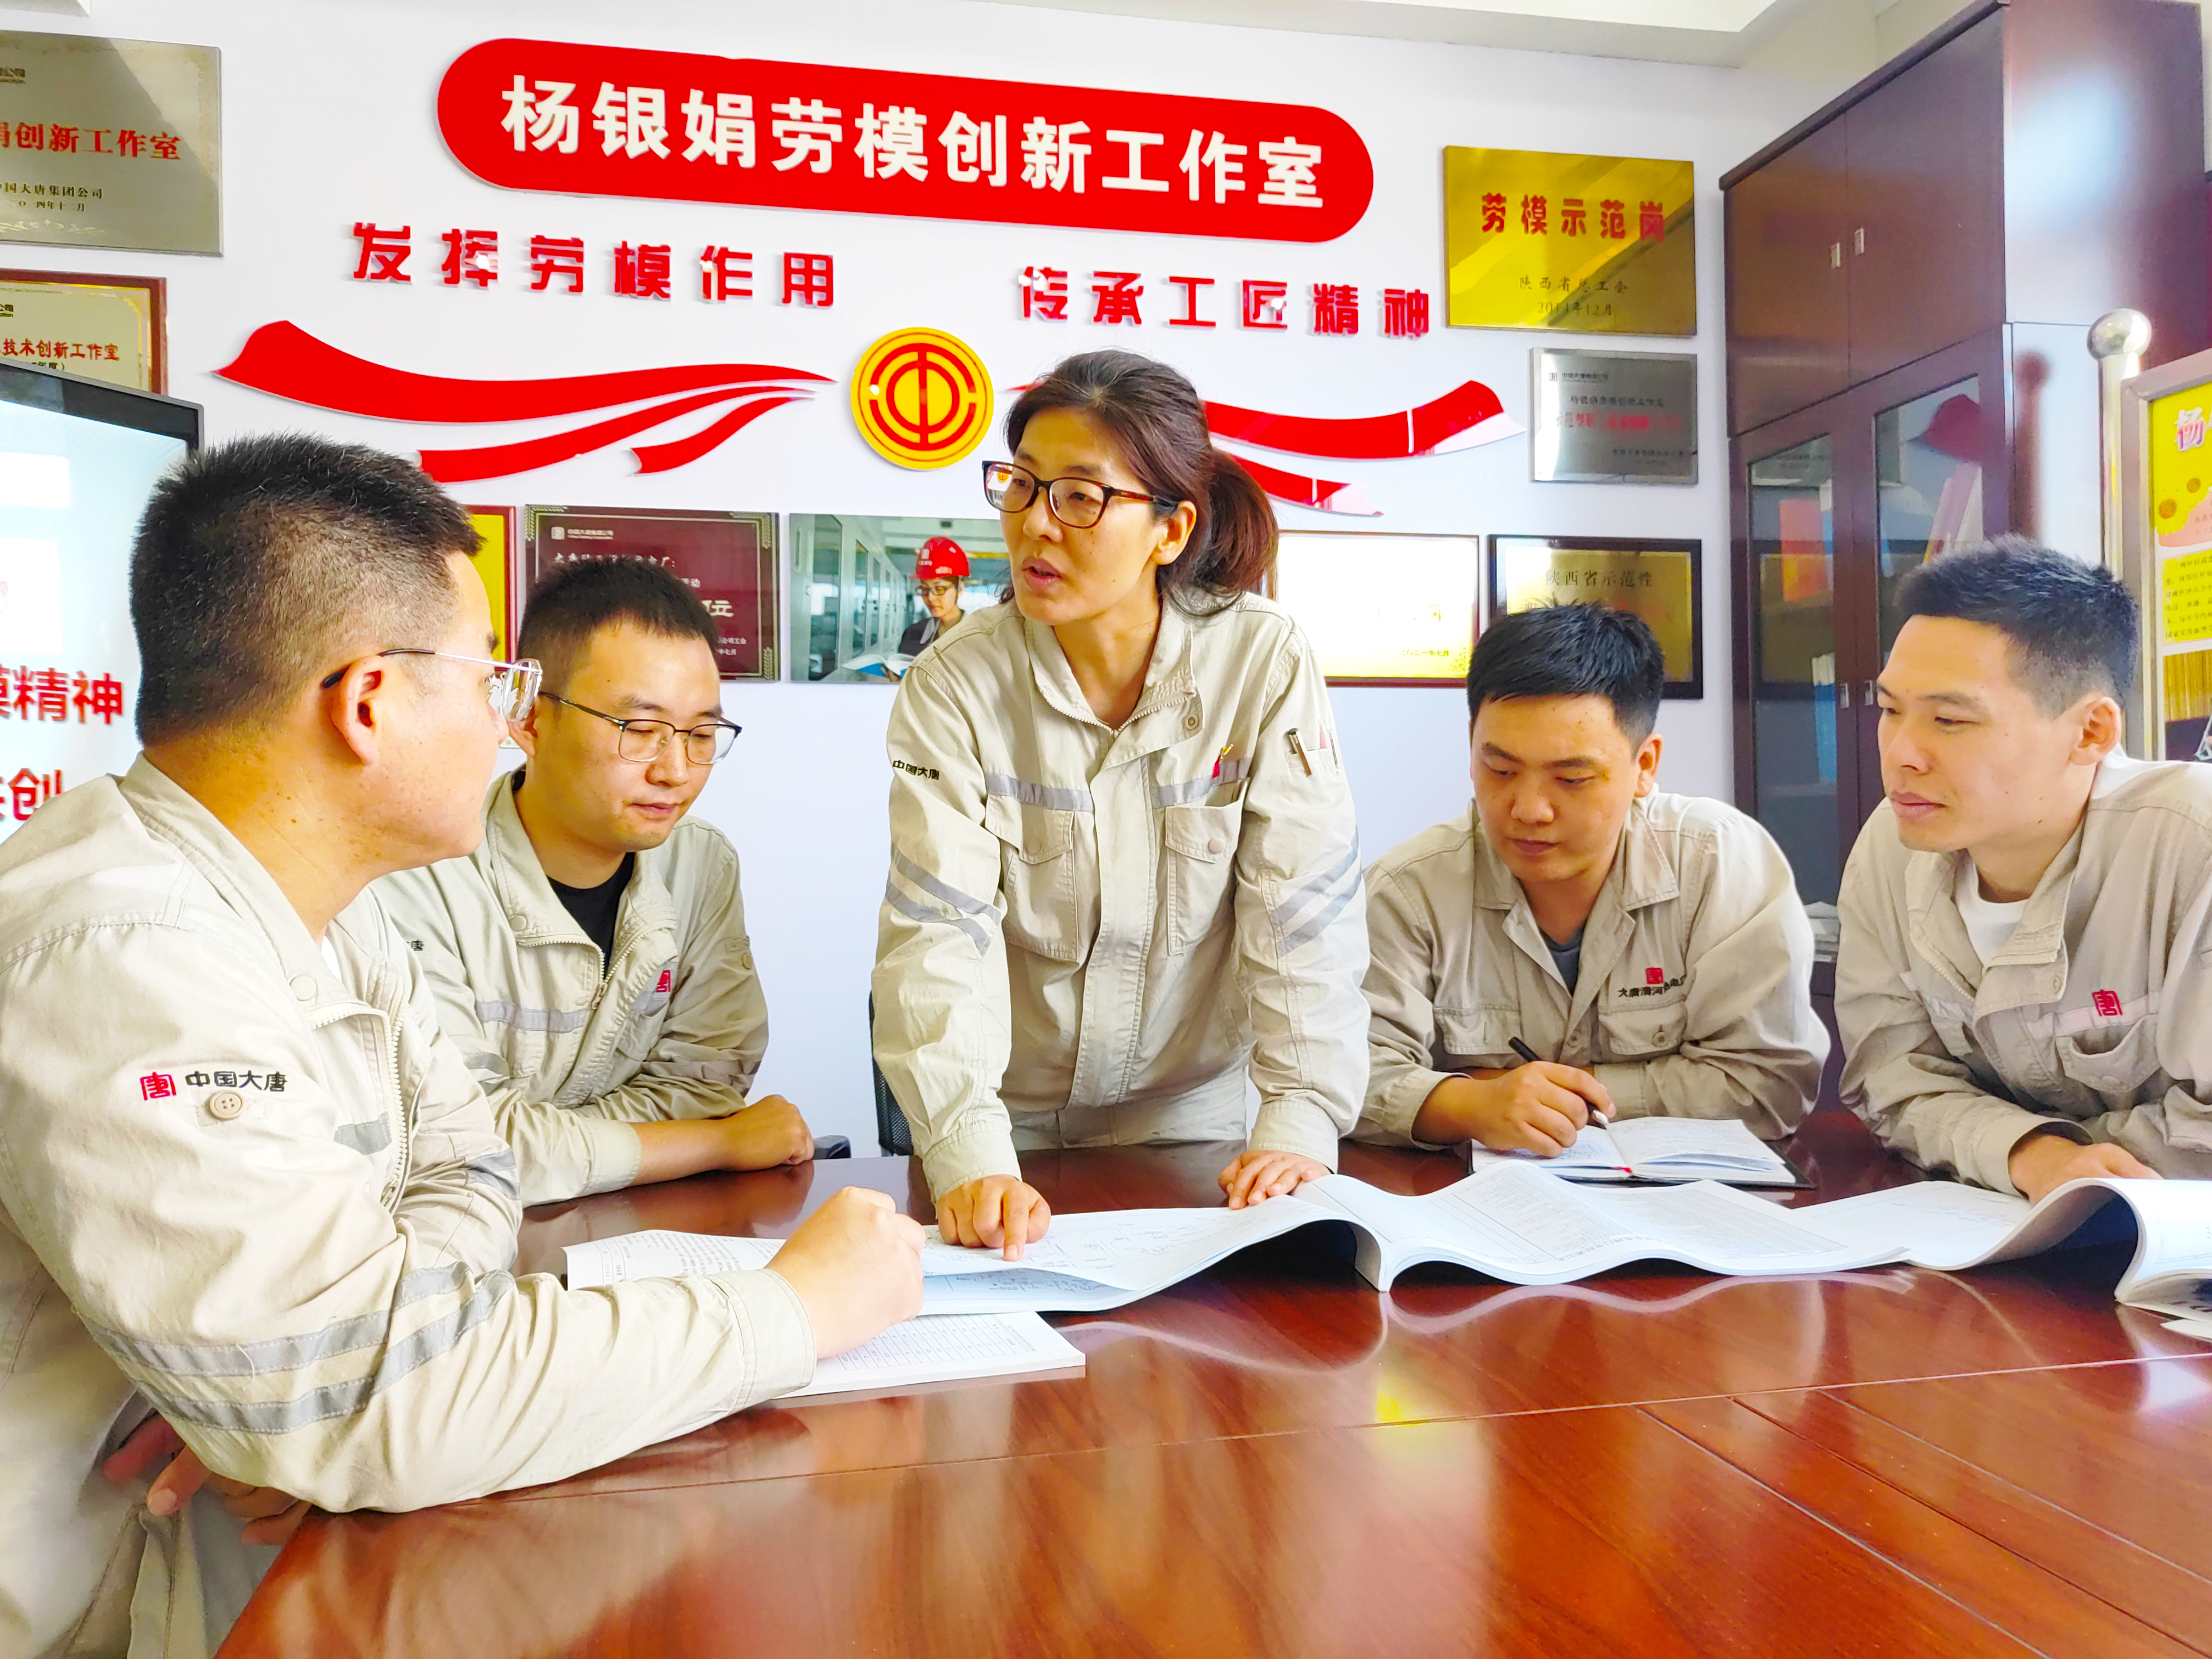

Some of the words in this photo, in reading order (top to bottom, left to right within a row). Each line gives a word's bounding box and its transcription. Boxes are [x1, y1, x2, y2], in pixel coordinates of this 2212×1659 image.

[501, 75, 1323, 208] 杨银娟劳模创新工作室
[1481, 192, 1666, 243] 劳模示范岗
[352, 221, 834, 307] 发挥劳模作用
[1021, 266, 1430, 338] 传承工匠精神
[1520, 275, 1627, 293] 陕西省总工会
[1546, 571, 1652, 587] 陕西省示范性
[0, 665, 124, 725] 精神
[893, 760, 940, 780] 中国大唐
[407, 939, 424, 951] 唐
[184, 1070, 287, 1092] 中国大唐
